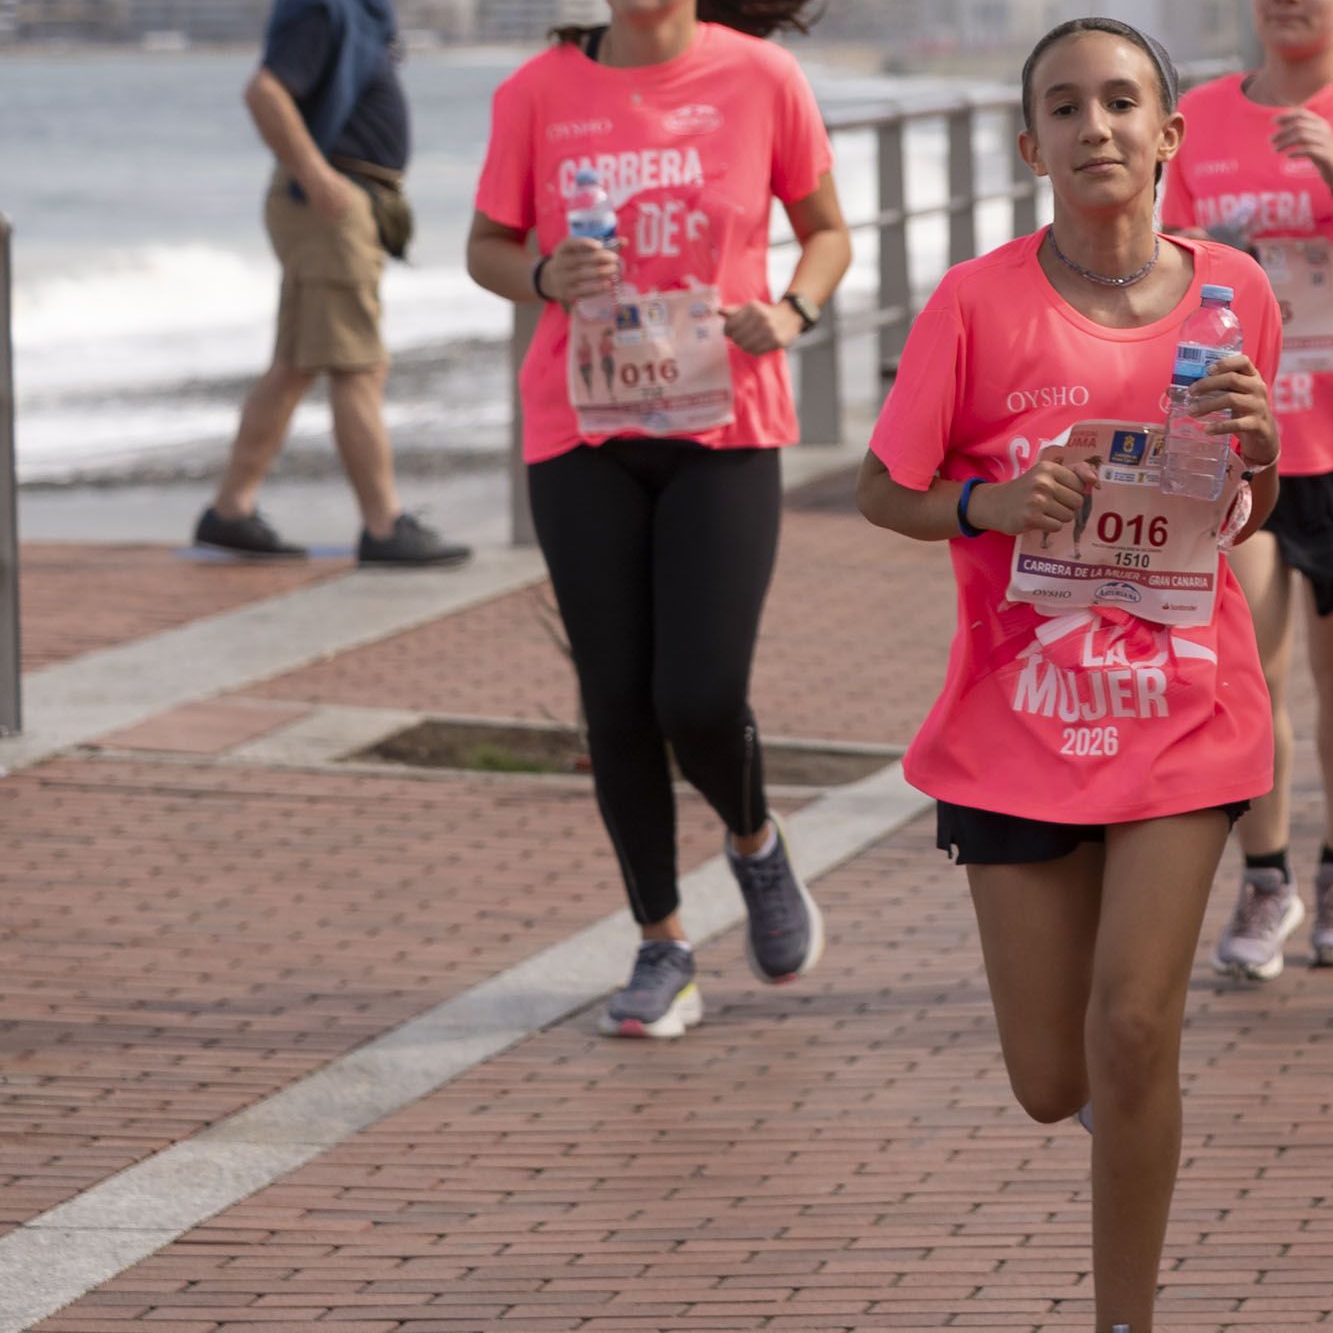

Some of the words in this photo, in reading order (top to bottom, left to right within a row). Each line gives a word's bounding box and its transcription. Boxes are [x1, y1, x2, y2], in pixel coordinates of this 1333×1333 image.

[621, 358, 678, 388] 016
[1007, 385, 1089, 413] OYSHO
[1097, 512, 1168, 547] 016
[1024, 559, 1071, 577] CARRERA
[1075, 566, 1088, 578] DE
[1089, 568, 1102, 578] LA
[1104, 568, 1141, 581] MUJER
[1149, 574, 1170, 586] GRAN
[1171, 575, 1208, 588] CANARIA
[1114, 552, 1149, 568] 1510
[1032, 588, 1071, 599] OYSHO
[1013, 657, 1169, 723] MUJER
[1060, 726, 1119, 757] 2026
